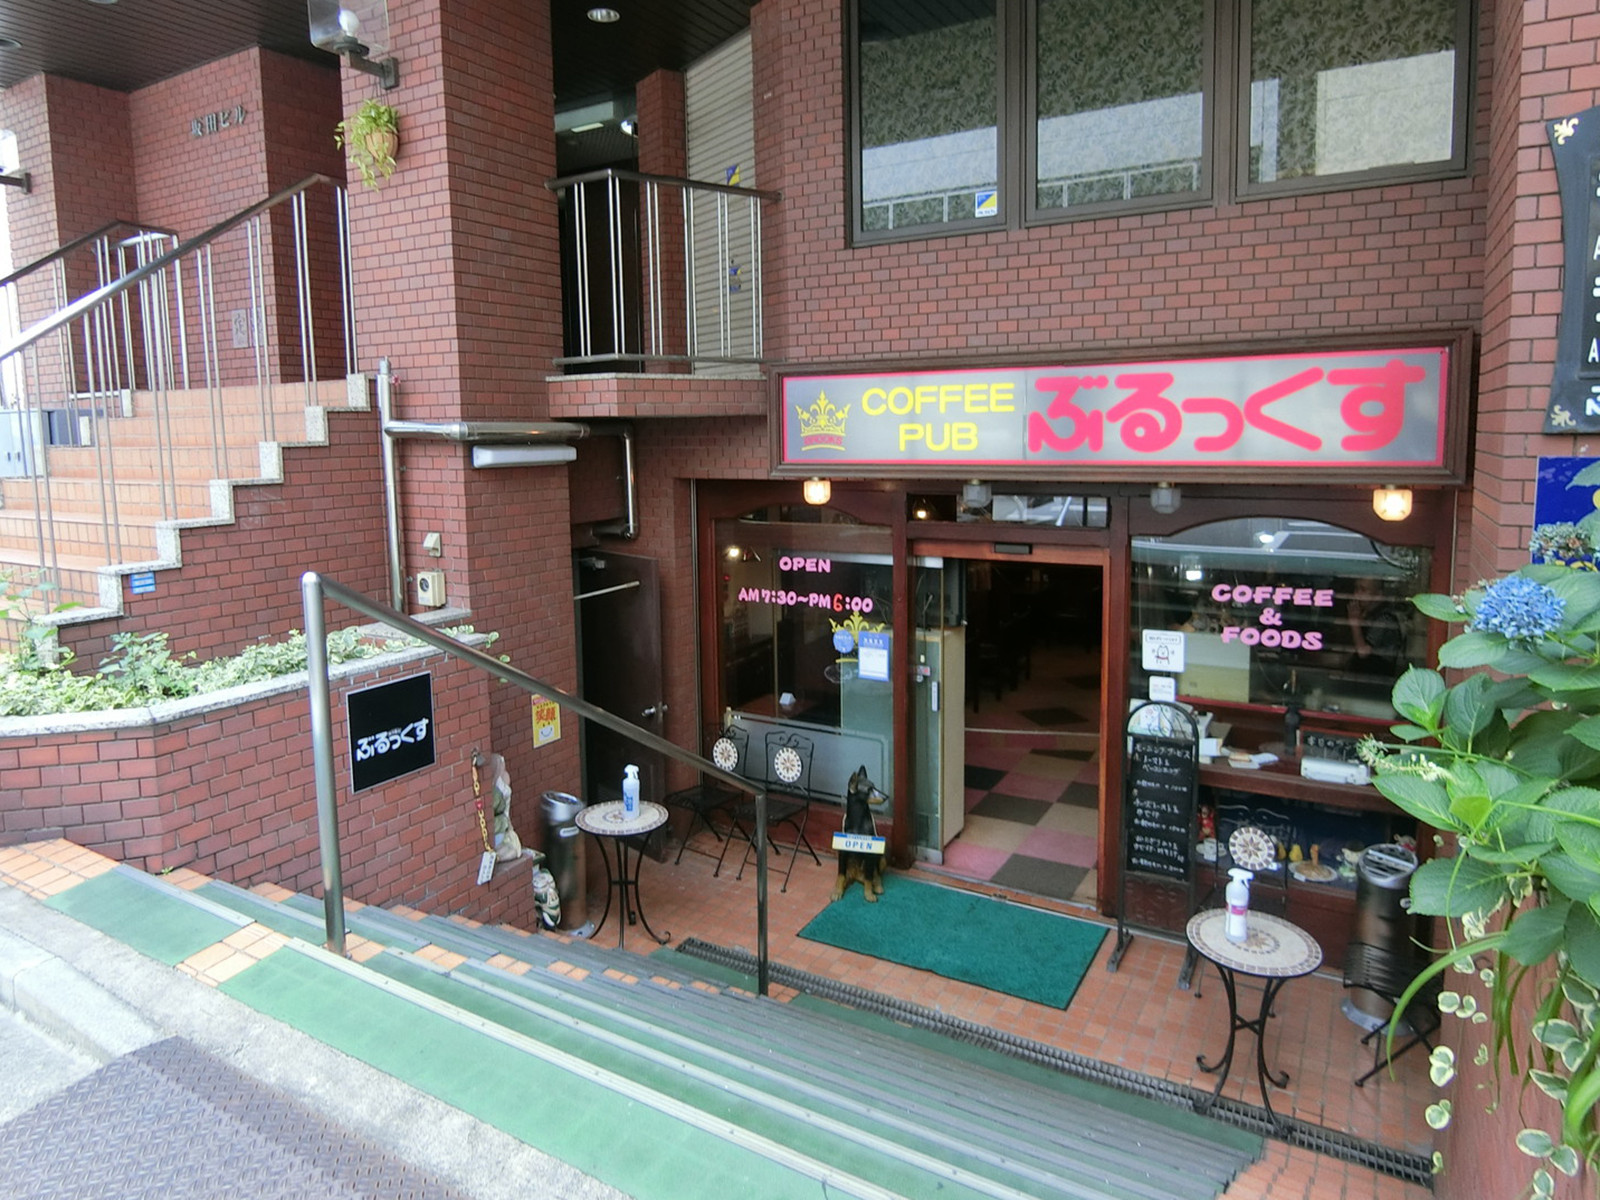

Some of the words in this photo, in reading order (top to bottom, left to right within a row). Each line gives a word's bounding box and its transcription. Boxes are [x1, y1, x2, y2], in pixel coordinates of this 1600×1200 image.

[861, 382, 1015, 417] COFFEE
[1028, 359, 1426, 453] ぶるっくす
[899, 421, 979, 452] PUB
[778, 556, 831, 573] OPEN
[1211, 583, 1334, 607] COFFEE
[1259, 607, 1283, 626] &
[1220, 626, 1323, 650] FOODS
[356, 717, 430, 762] ぶるっくす
[845, 840, 872, 850] OPEN
